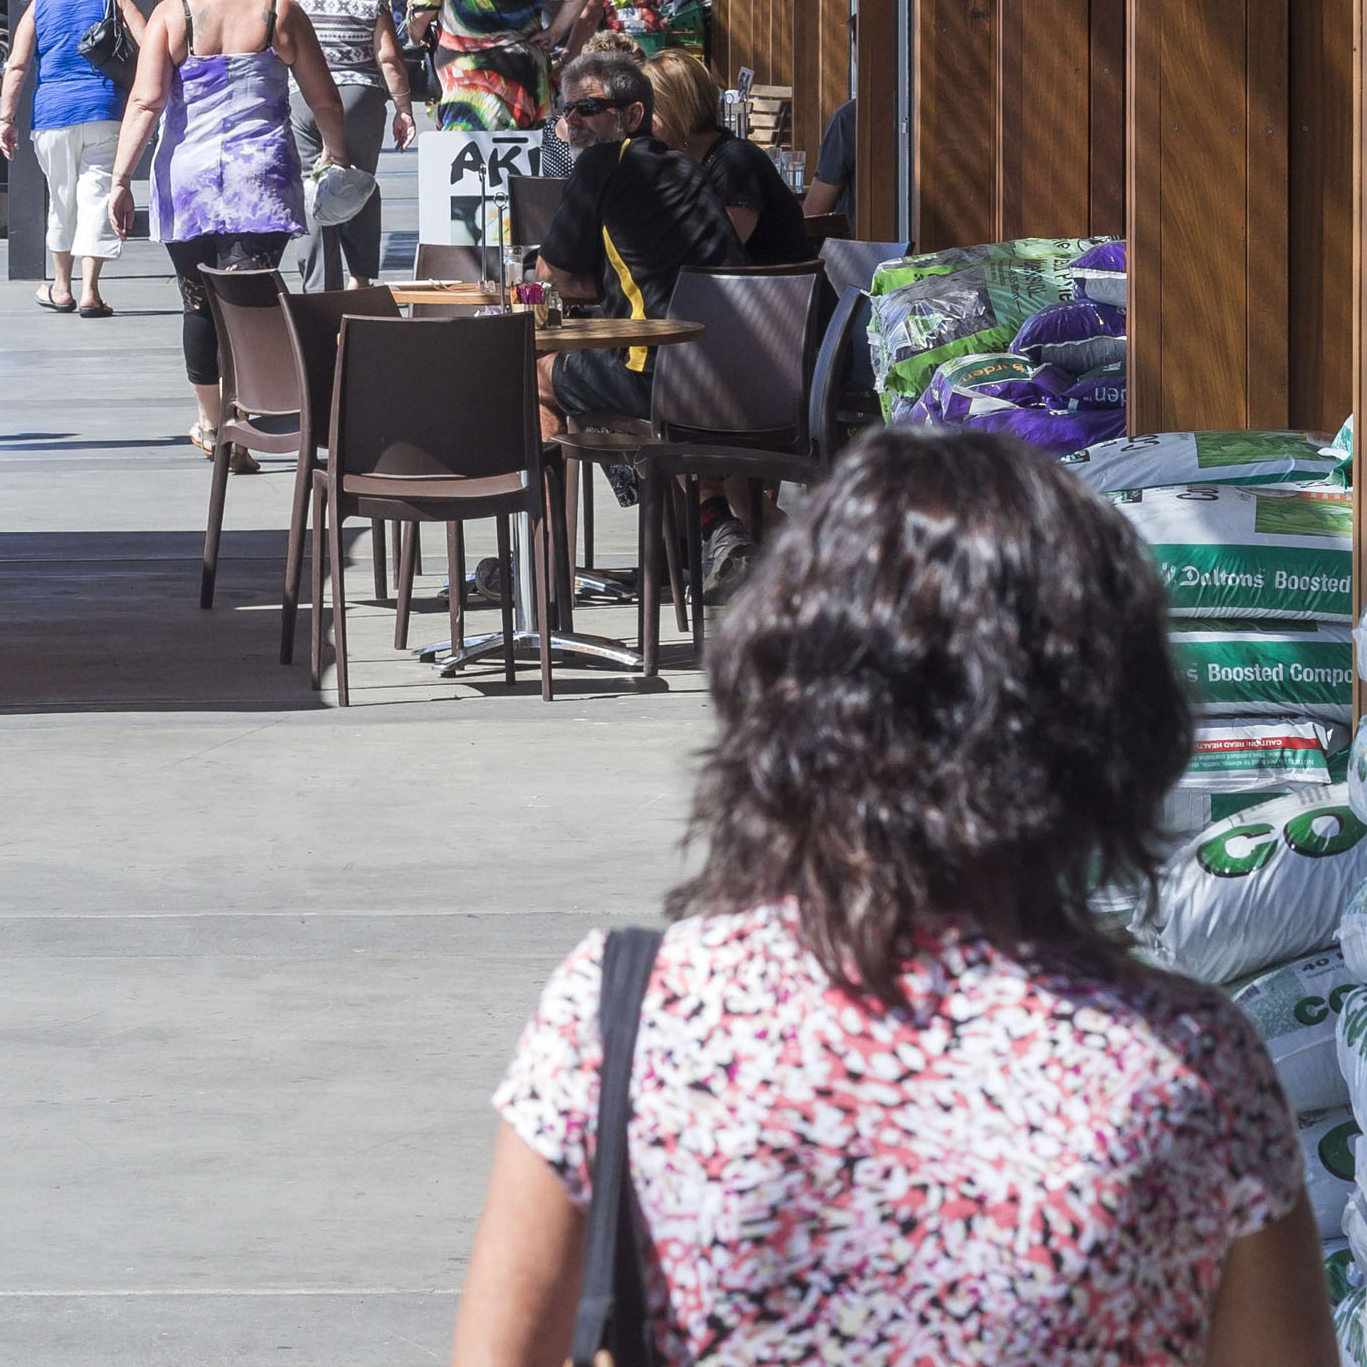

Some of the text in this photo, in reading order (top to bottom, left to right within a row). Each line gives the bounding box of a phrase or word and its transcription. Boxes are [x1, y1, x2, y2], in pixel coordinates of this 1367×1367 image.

[1180, 566, 1351, 593] Daltons Boosted
[1207, 663, 1284, 682] Boosted
